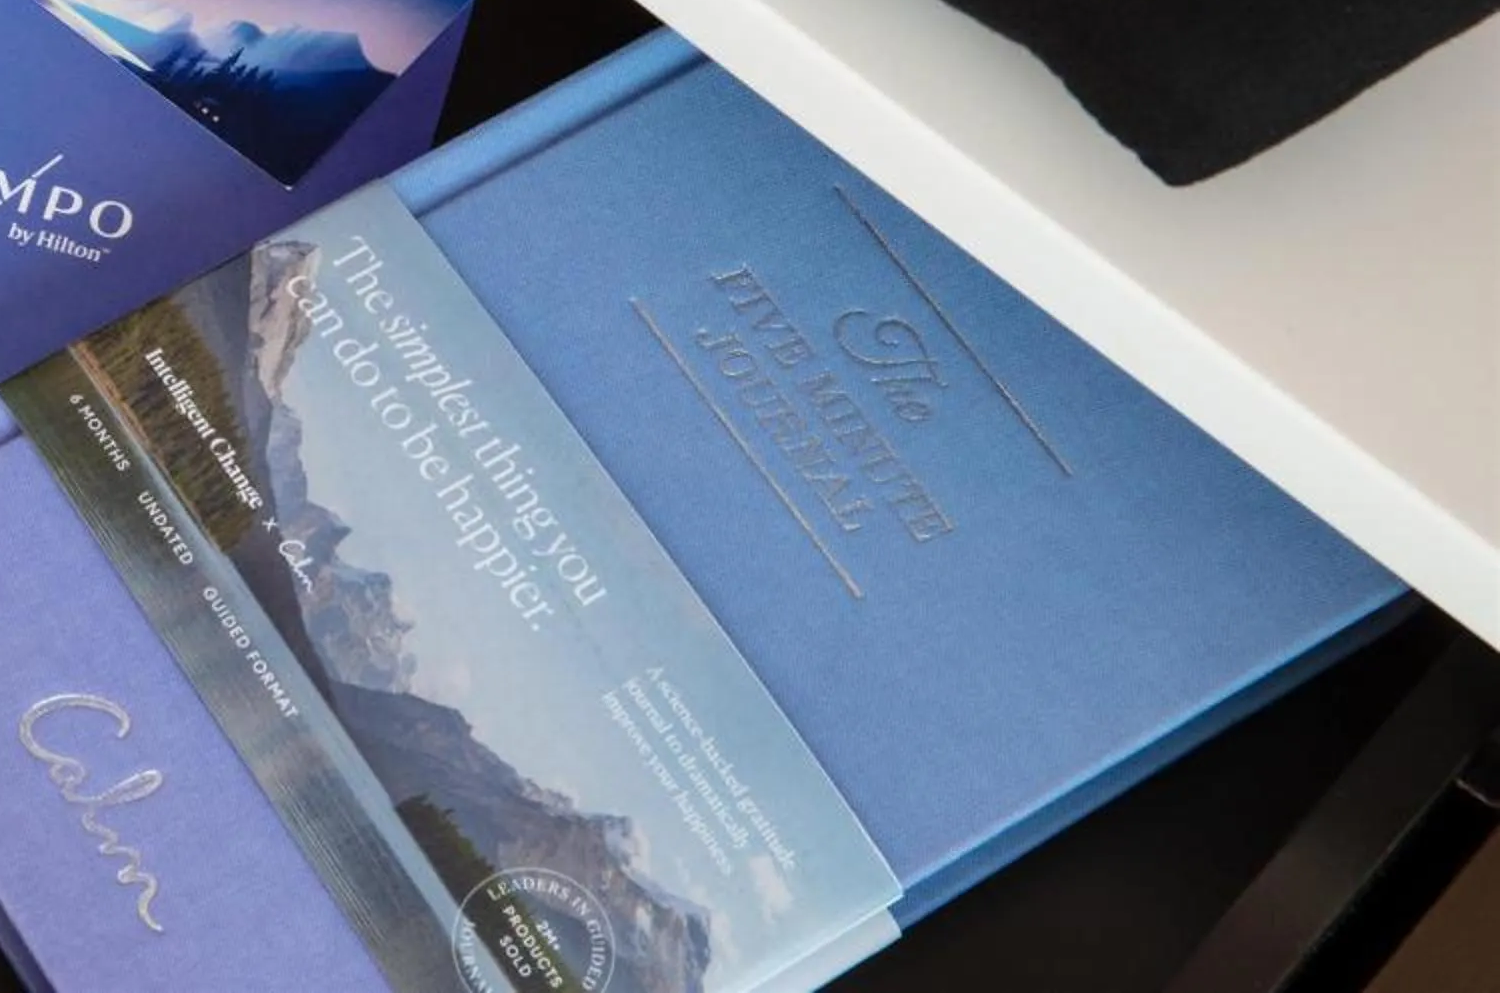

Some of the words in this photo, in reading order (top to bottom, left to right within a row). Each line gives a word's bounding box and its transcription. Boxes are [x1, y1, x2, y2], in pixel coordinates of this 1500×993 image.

[7, 222, 35, 247] by
[332, 235, 394, 315] The
[379, 322, 490, 438] simplest
[474, 437, 560, 541] thing
[531, 532, 607, 607] you
[707, 262, 815, 370] FIVE
[803, 370, 955, 543] MINUTE
[833, 308, 948, 422] The
[69, 394, 82, 407] 6
[78, 404, 132, 473] MONTHS
[146, 347, 216, 440] Intelligent
[209, 437, 264, 510] Change
[278, 539, 314, 594] Calm
[287, 275, 345, 338] can
[332, 341, 381, 388] do
[370, 385, 411, 431] to
[401, 422, 451, 481] be
[435, 473, 555, 632] happier.
[695, 327, 872, 533] JOURNAL
[137, 490, 194, 567] UNDATED
[202, 586, 251, 649] GUIDED
[245, 650, 299, 719] FORMAT
[601, 690, 652, 756] improve
[644, 754, 680, 792] your
[622, 677, 674, 734] journal
[665, 734, 683, 753] to
[678, 755, 750, 849] dramatically
[19, 693, 164, 932] Calm
[736, 795, 796, 871] gratitude
[486, 876, 571, 902] LEADERS
[571, 895, 590, 917] IN
[582, 918, 606, 992] GUIDED
[499, 935, 533, 977] SOLD
[502, 904, 564, 989] PRODUCTS
